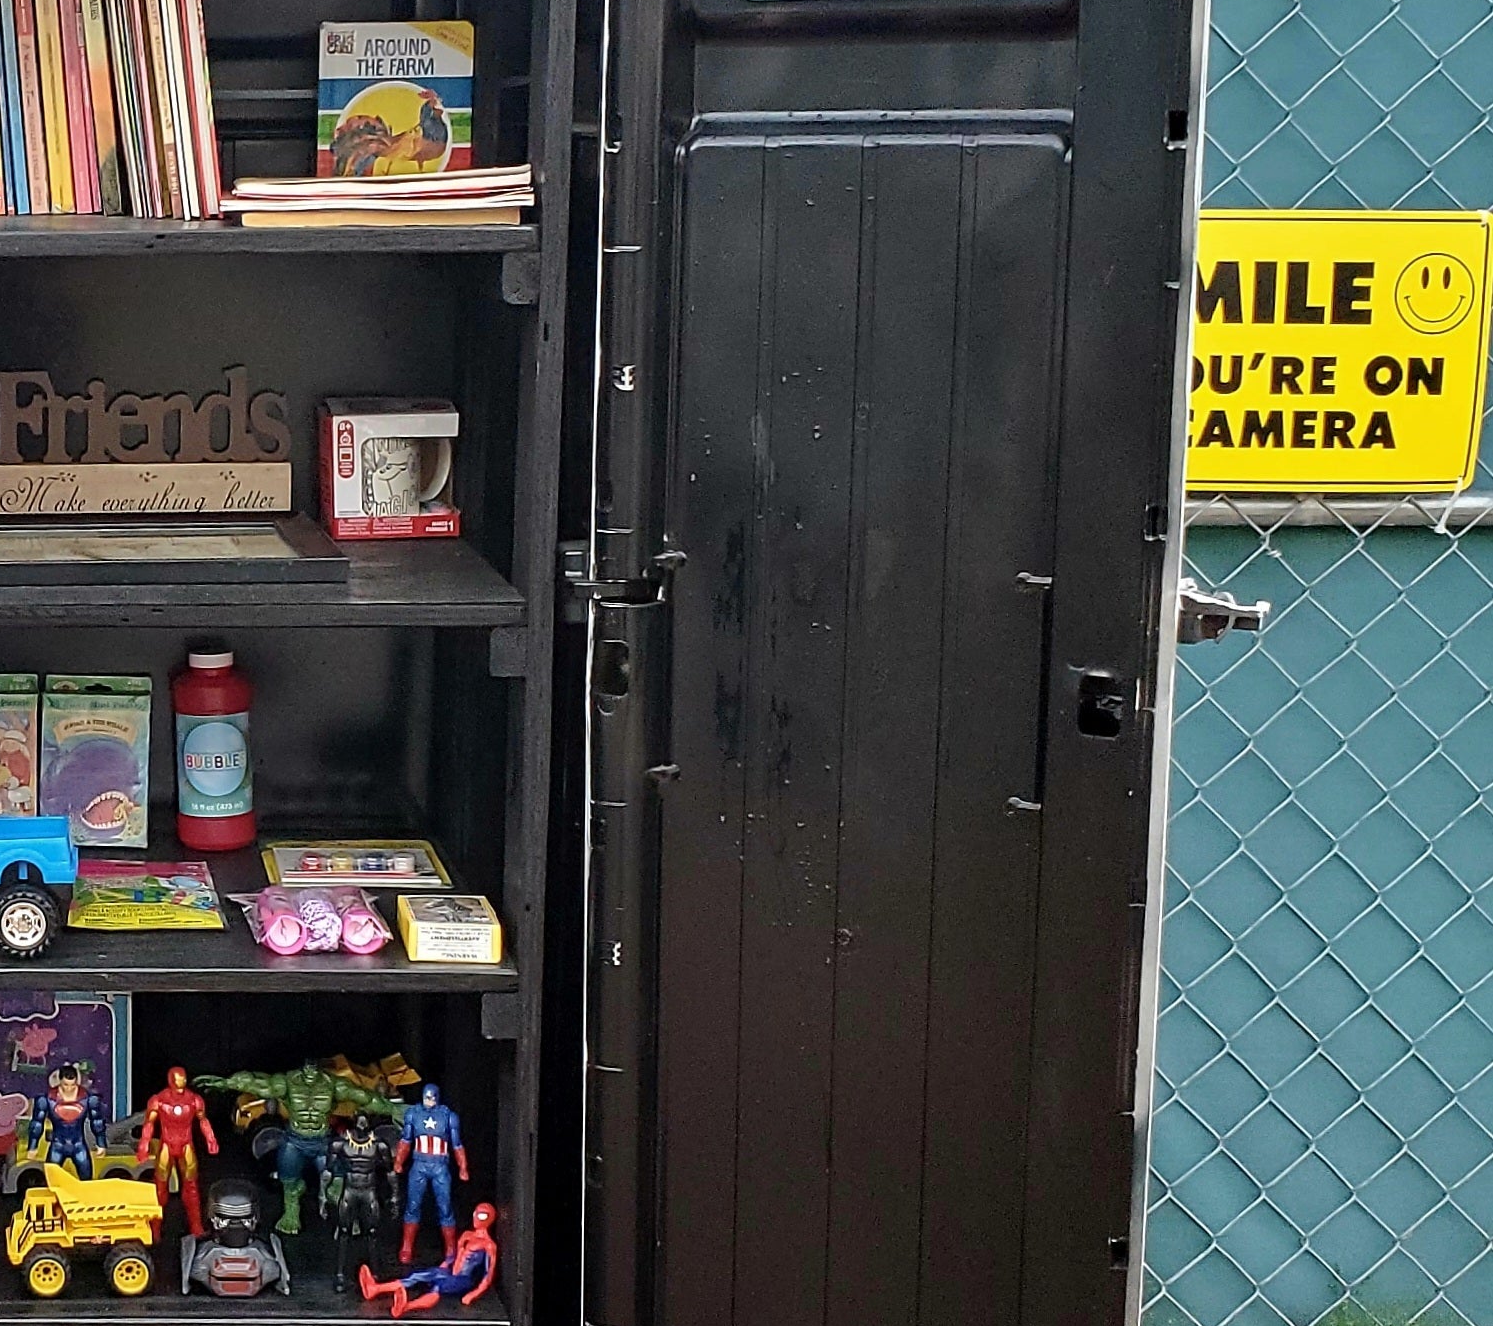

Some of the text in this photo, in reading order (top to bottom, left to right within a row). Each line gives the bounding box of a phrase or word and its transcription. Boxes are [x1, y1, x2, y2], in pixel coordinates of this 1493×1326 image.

[363, 38, 431, 57] AROUND
[356, 57, 435, 76] THE FARM
[1195, 261, 1375, 325] MILE
[1191, 353, 1445, 396] U'RE ON
[0, 476, 276, 513] Make everything better
